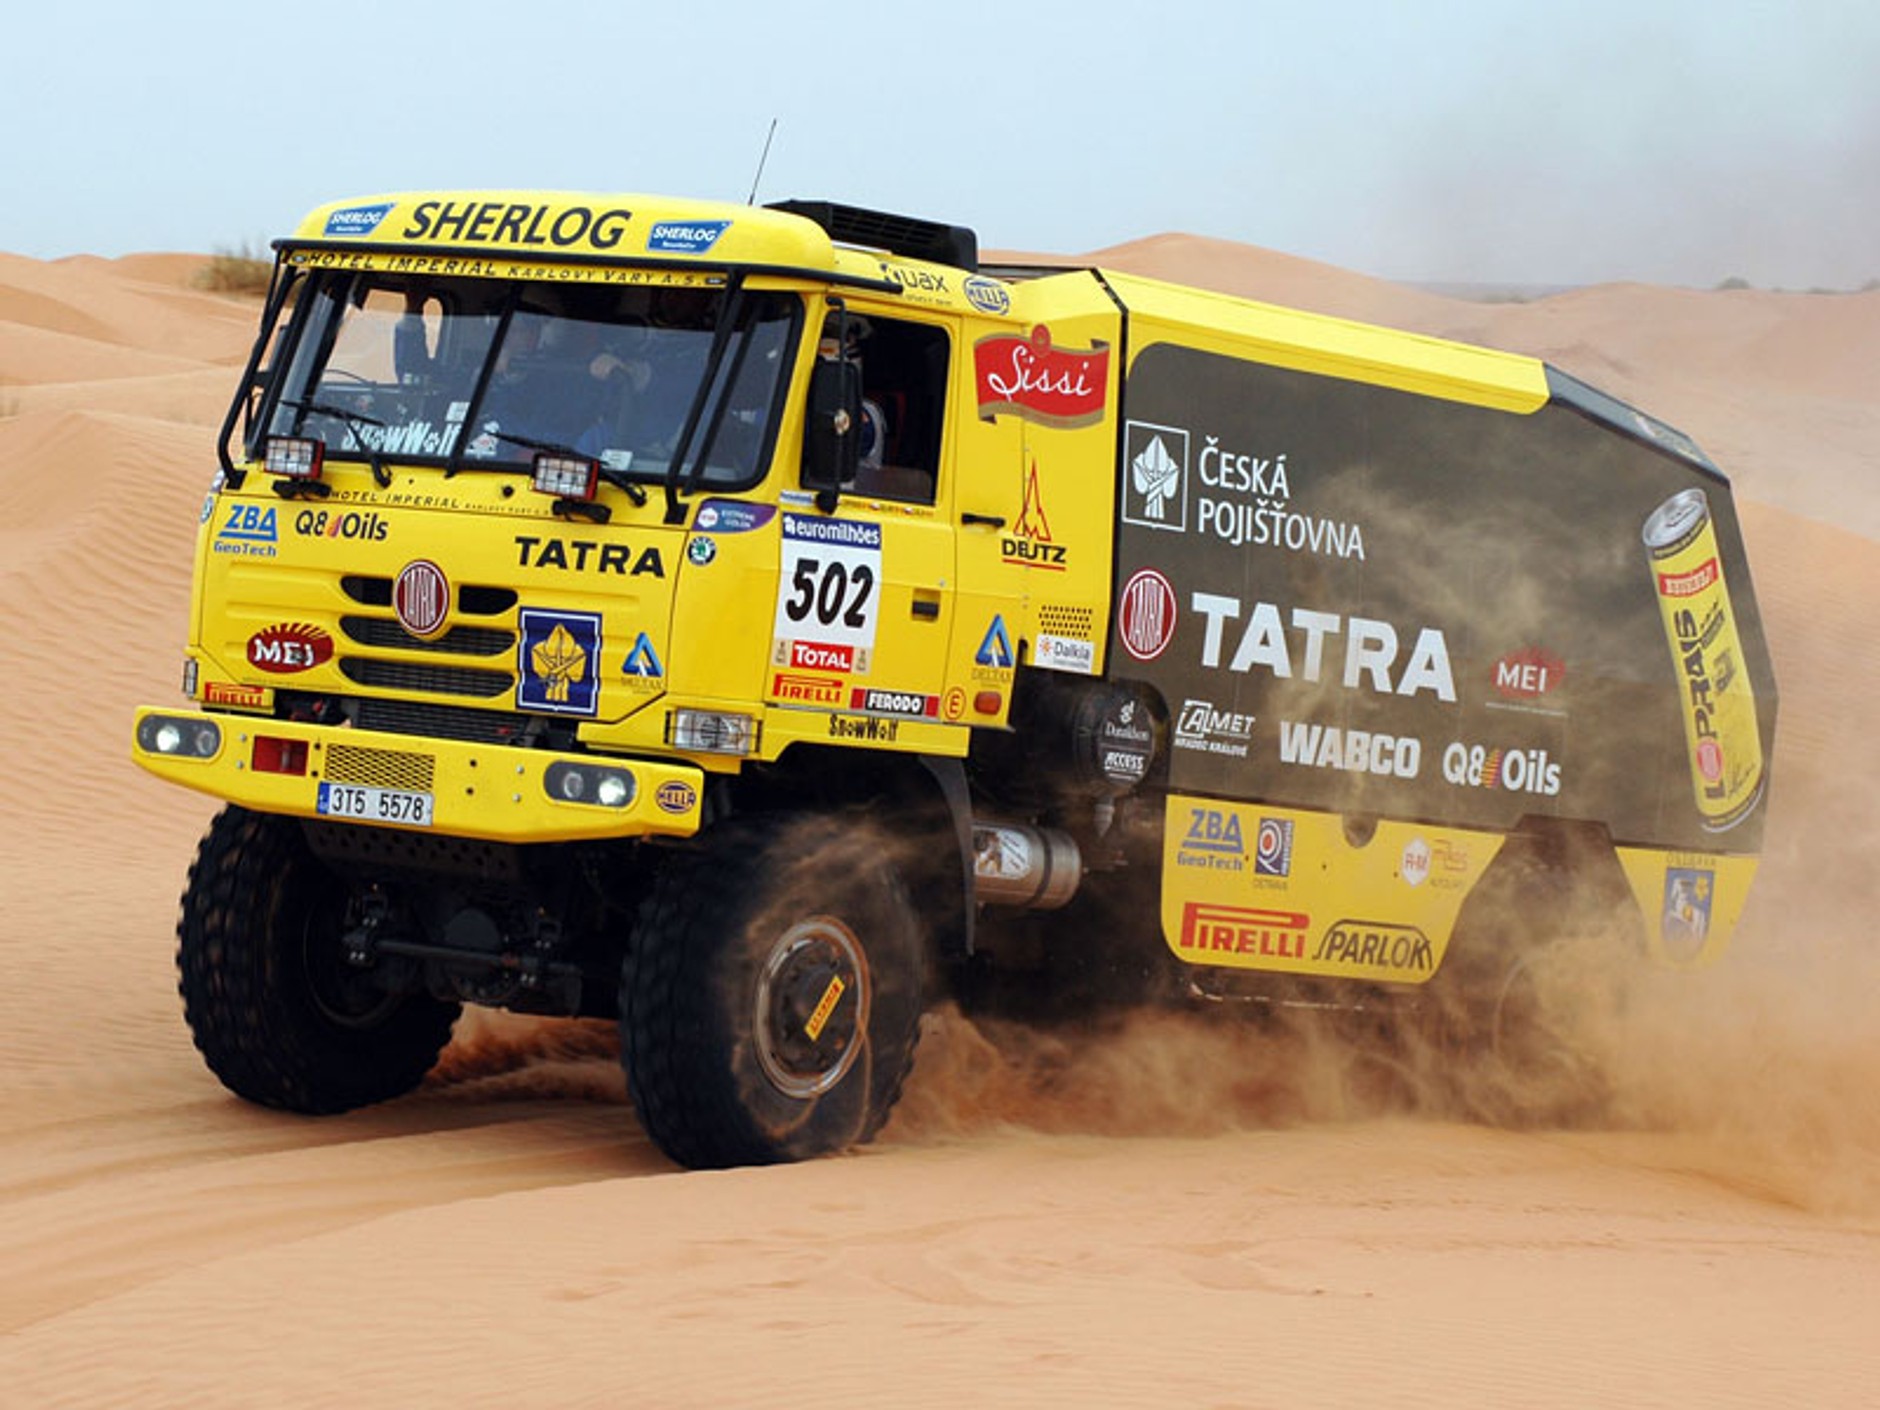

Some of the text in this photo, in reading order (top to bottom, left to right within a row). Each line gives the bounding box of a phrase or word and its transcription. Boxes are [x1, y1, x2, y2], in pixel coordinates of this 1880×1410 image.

[402, 201, 632, 250] SHERLOG
[653, 224, 717, 243] SHERLOG
[310, 252, 374, 269] HOTEL
[387, 256, 496, 276] IMPERIAL
[507, 266, 595, 280] KARLOVY
[603, 270, 652, 283] VARY
[987, 345, 1092, 402] Sissi
[1199, 434, 1290, 499] ČESKÁ
[385, 494, 460, 509] IMPERIAL
[1198, 497, 1366, 561] POJIŠŤOVNA
[213, 540, 277, 558] GeoTech
[514, 535, 666, 579] TATRA
[1001, 537, 1068, 564] DEUTZ
[785, 556, 875, 629] 502
[253, 637, 315, 667] MEI
[794, 644, 851, 670] TOTAL
[1053, 640, 1091, 661] Dalkia
[1191, 591, 1457, 702] TATRA
[772, 672, 844, 704] PIRELLI
[1496, 660, 1548, 692] MEI
[204, 681, 265, 707] PIRELLI
[866, 692, 923, 713] FERODO
[828, 713, 899, 742] SnowWolf
[1279, 720, 1421, 779] WABCO
[1442, 742, 1562, 796] Q8 Oils
[332, 786, 425, 823] 3T5 5578
[1187, 808, 1244, 843] ZBA
[1176, 850, 1244, 872] GeoTech
[1179, 901, 1311, 959] PIRELLI
[1324, 929, 1434, 971] PARLOK
